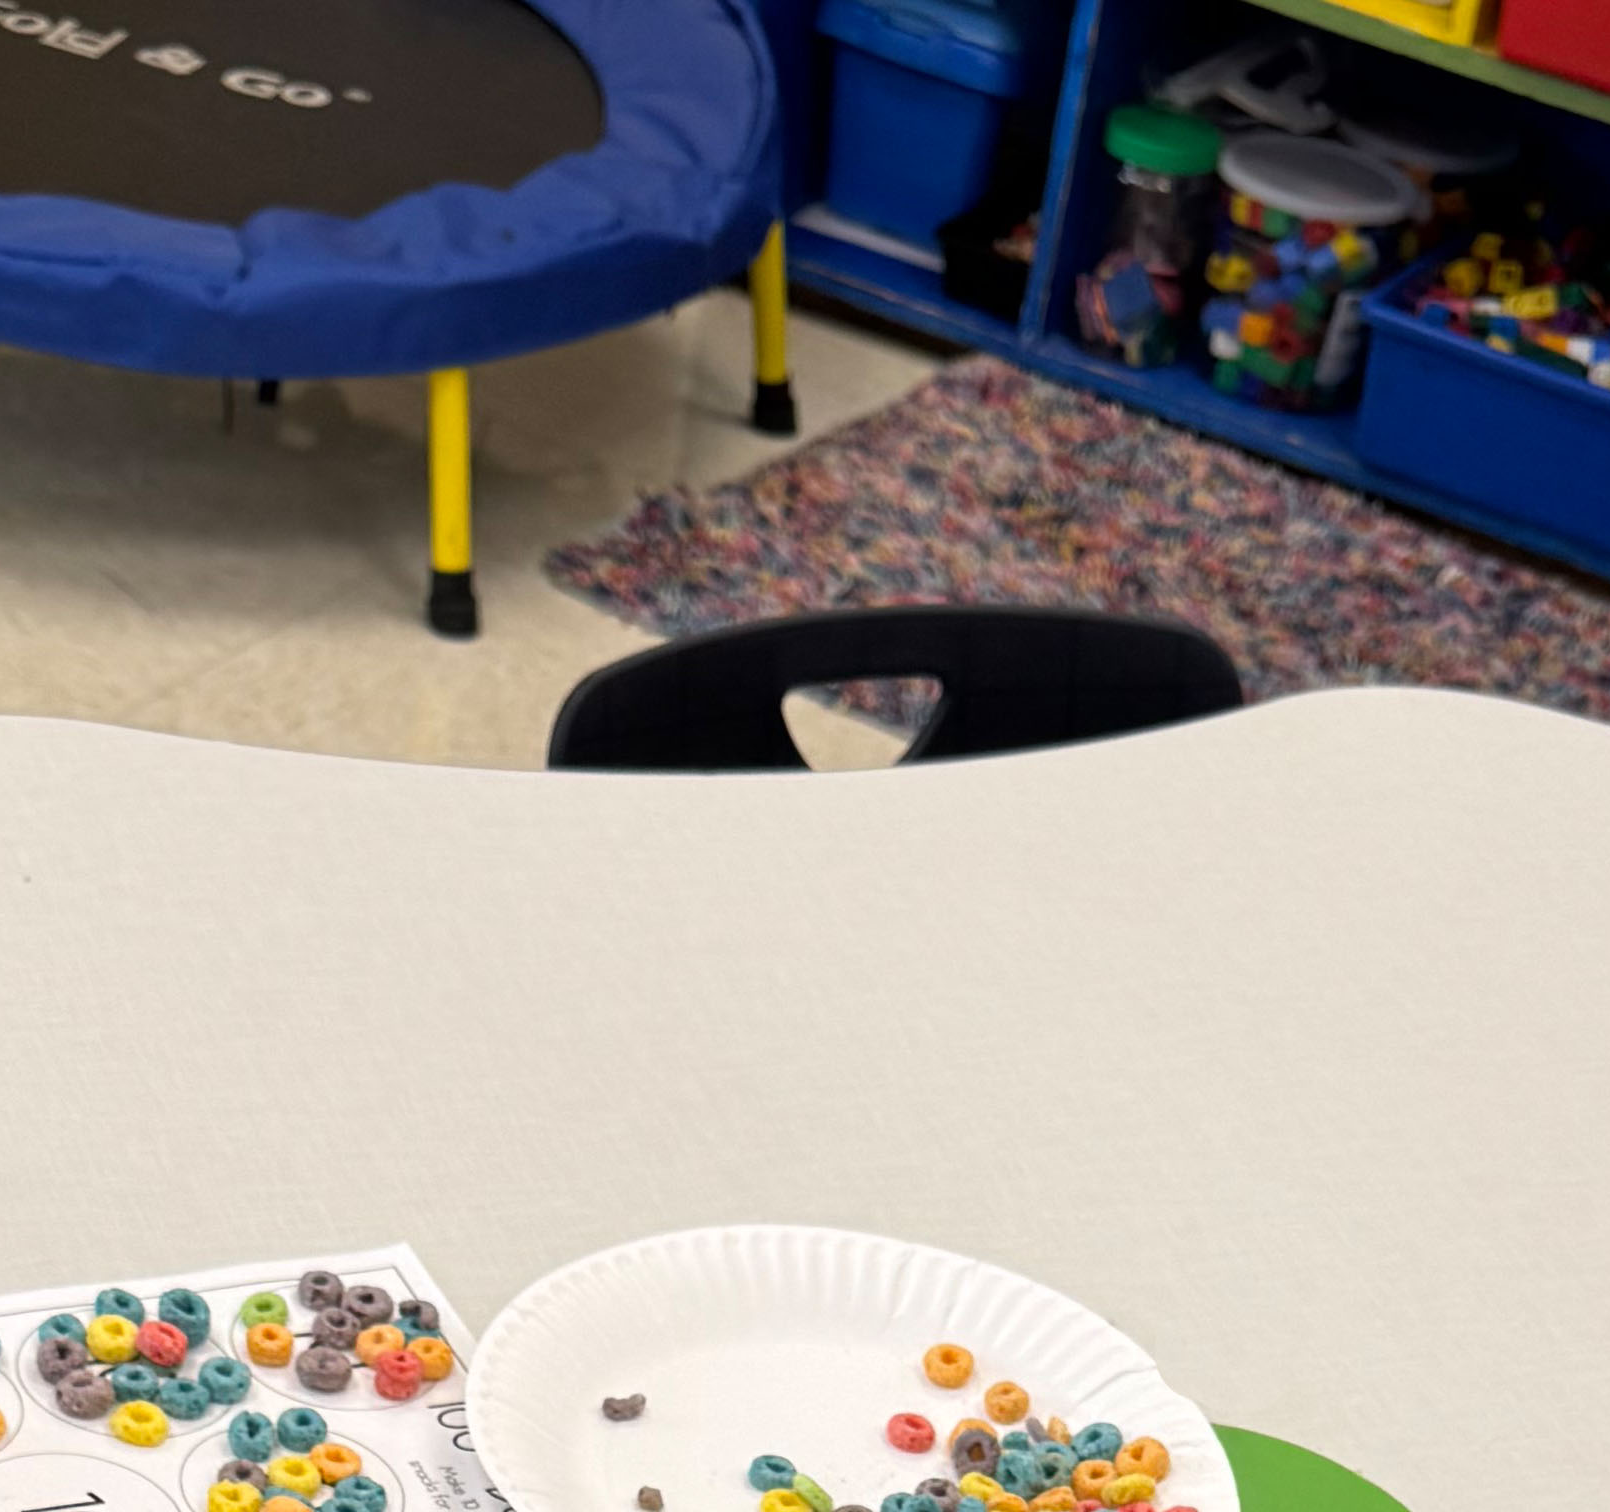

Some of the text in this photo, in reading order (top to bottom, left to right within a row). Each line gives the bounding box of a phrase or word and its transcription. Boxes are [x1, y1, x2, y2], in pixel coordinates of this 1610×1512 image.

[134, 43, 208, 76] &
[220, 65, 334, 108] Go
[409, 1461, 440, 1493] snacks
[438, 1466, 465, 1495] Make
